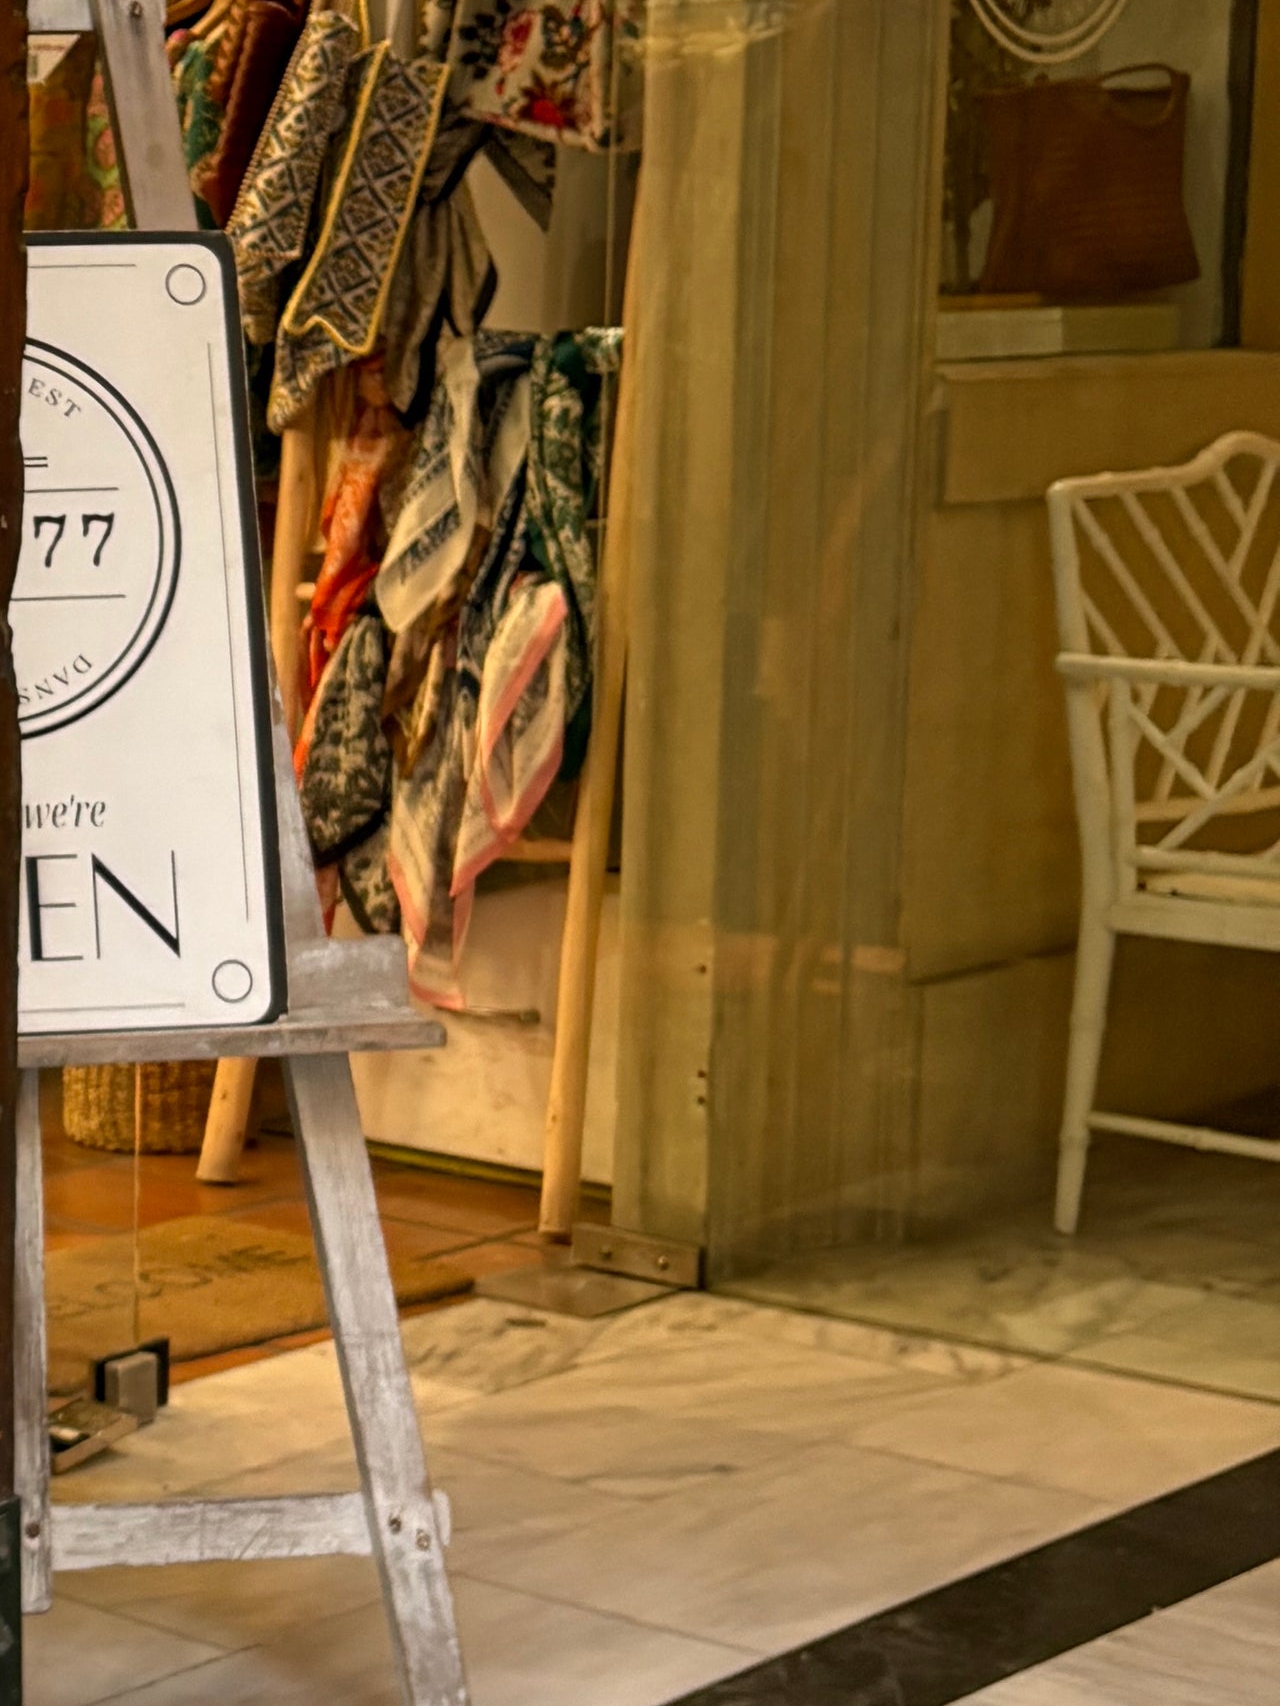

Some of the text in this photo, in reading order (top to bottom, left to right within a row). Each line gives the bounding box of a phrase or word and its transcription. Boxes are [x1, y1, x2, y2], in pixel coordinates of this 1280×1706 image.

[27, 377, 82, 417] EST
[32, 512, 115, 568] 77
[25, 794, 107, 829] we're
[25, 849, 182, 961] EN
